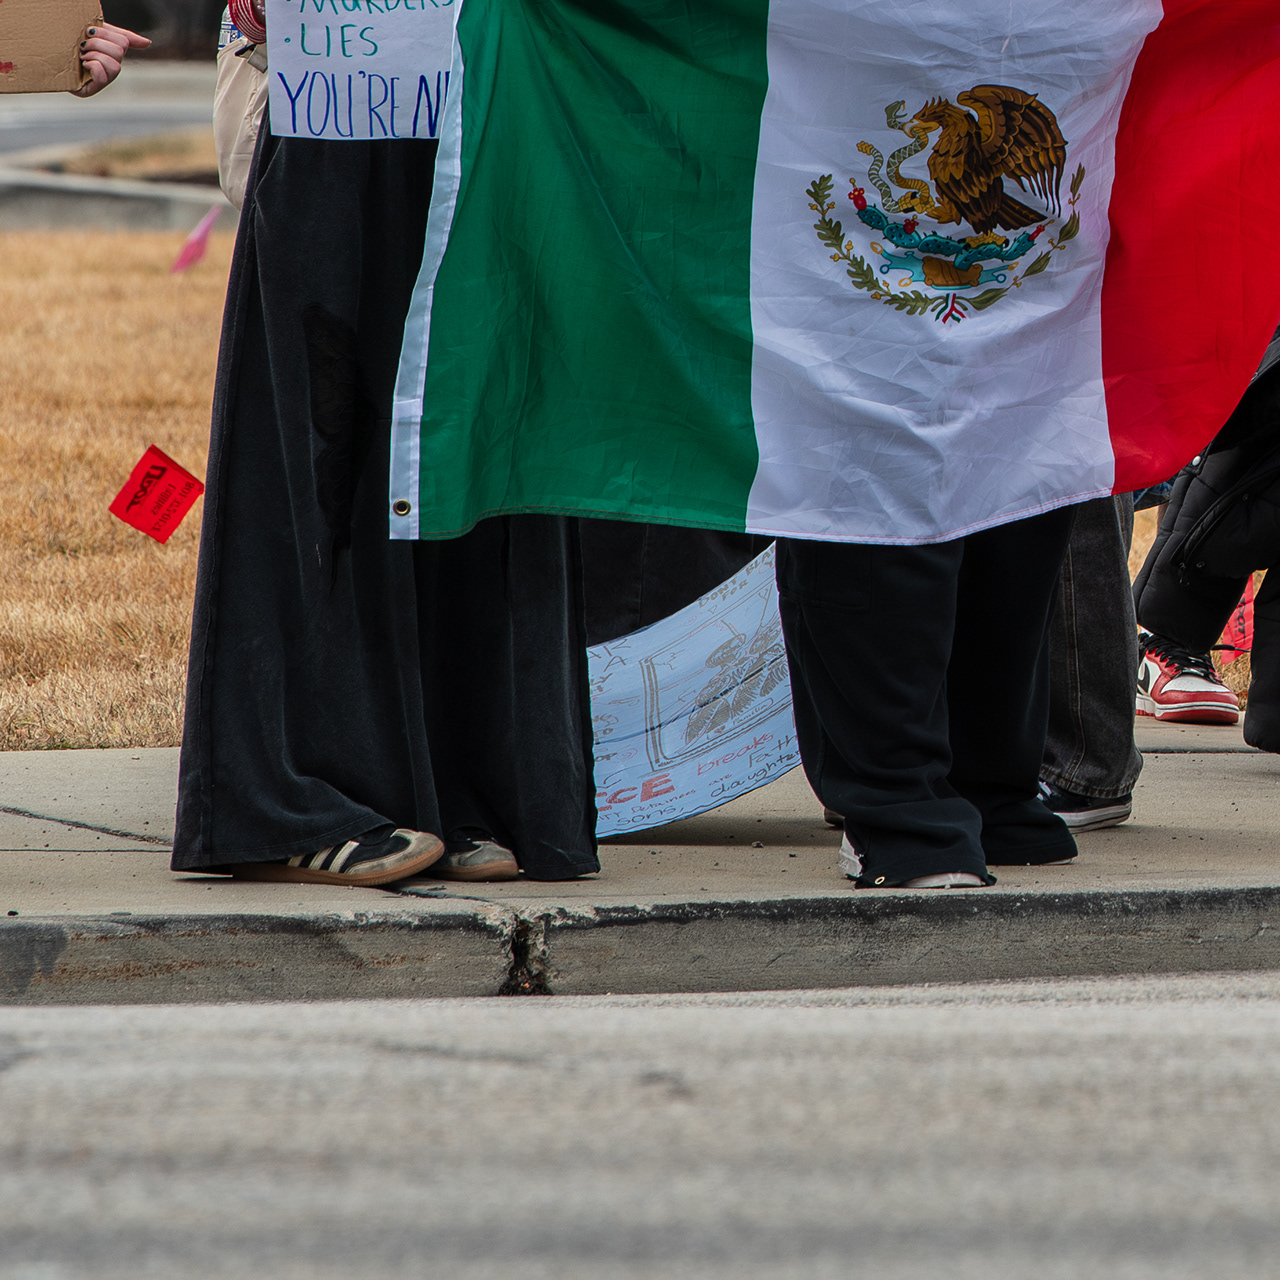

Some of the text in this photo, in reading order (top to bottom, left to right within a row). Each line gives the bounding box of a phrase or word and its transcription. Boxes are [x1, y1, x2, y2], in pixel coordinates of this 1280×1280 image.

[300, 22, 378, 58] LIES
[276, 70, 400, 138] YOU'RE
[697, 733, 775, 776] breaks
